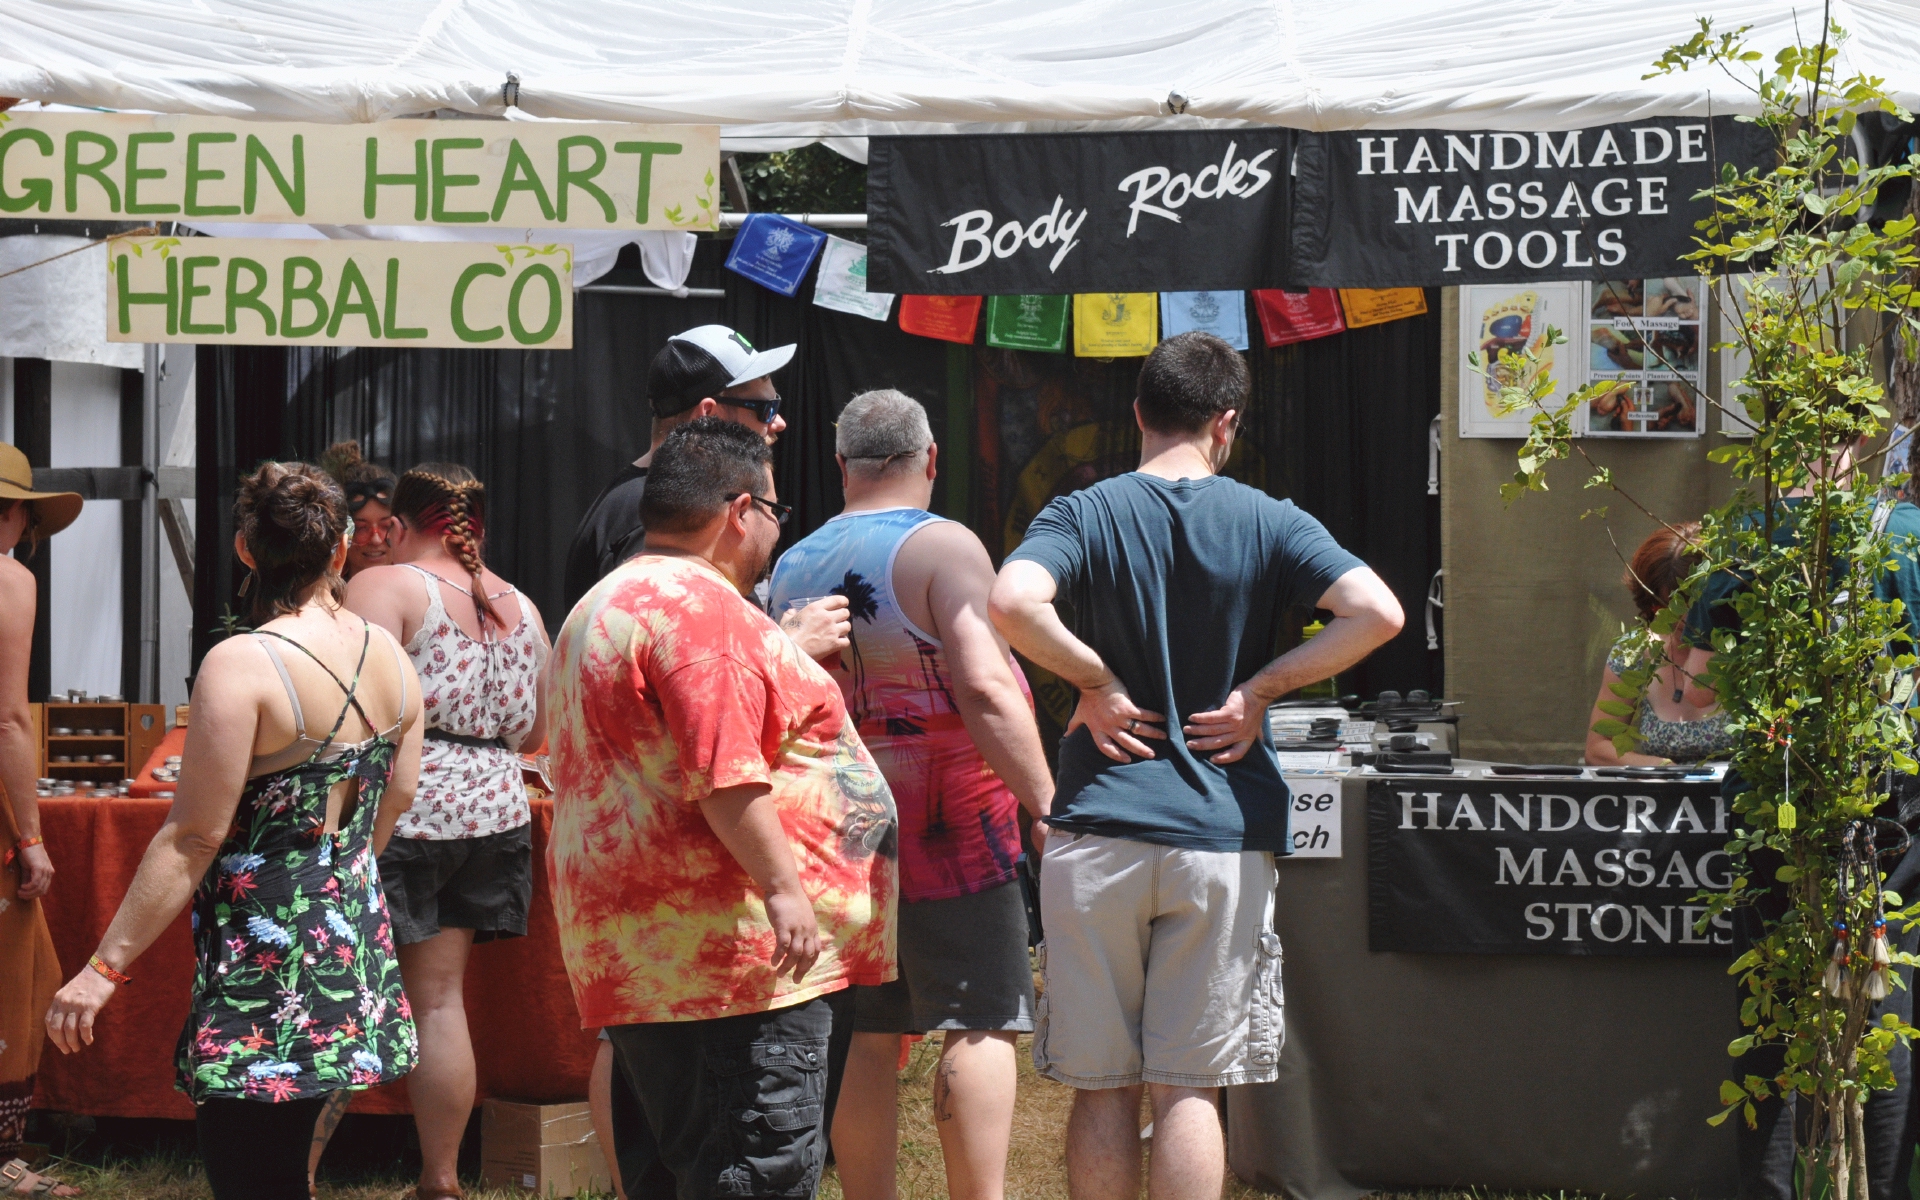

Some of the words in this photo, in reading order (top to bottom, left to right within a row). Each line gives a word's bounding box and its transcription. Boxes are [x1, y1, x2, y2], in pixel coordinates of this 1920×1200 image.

[1357, 124, 1707, 174] HANDMADE
[0, 129, 304, 216] GREEN
[364, 135, 682, 224] HEART
[1394, 176, 1668, 224] MASSAGE
[927, 195, 1088, 274] Body
[1118, 141, 1276, 238] Rocks
[1435, 229, 1627, 272] TOOLS
[117, 254, 428, 339] HERBAL
[451, 263, 562, 345] CO
[1640, 319, 1678, 329] Massage
[1291, 793, 1334, 812] se
[1525, 903, 1732, 945] STONES
